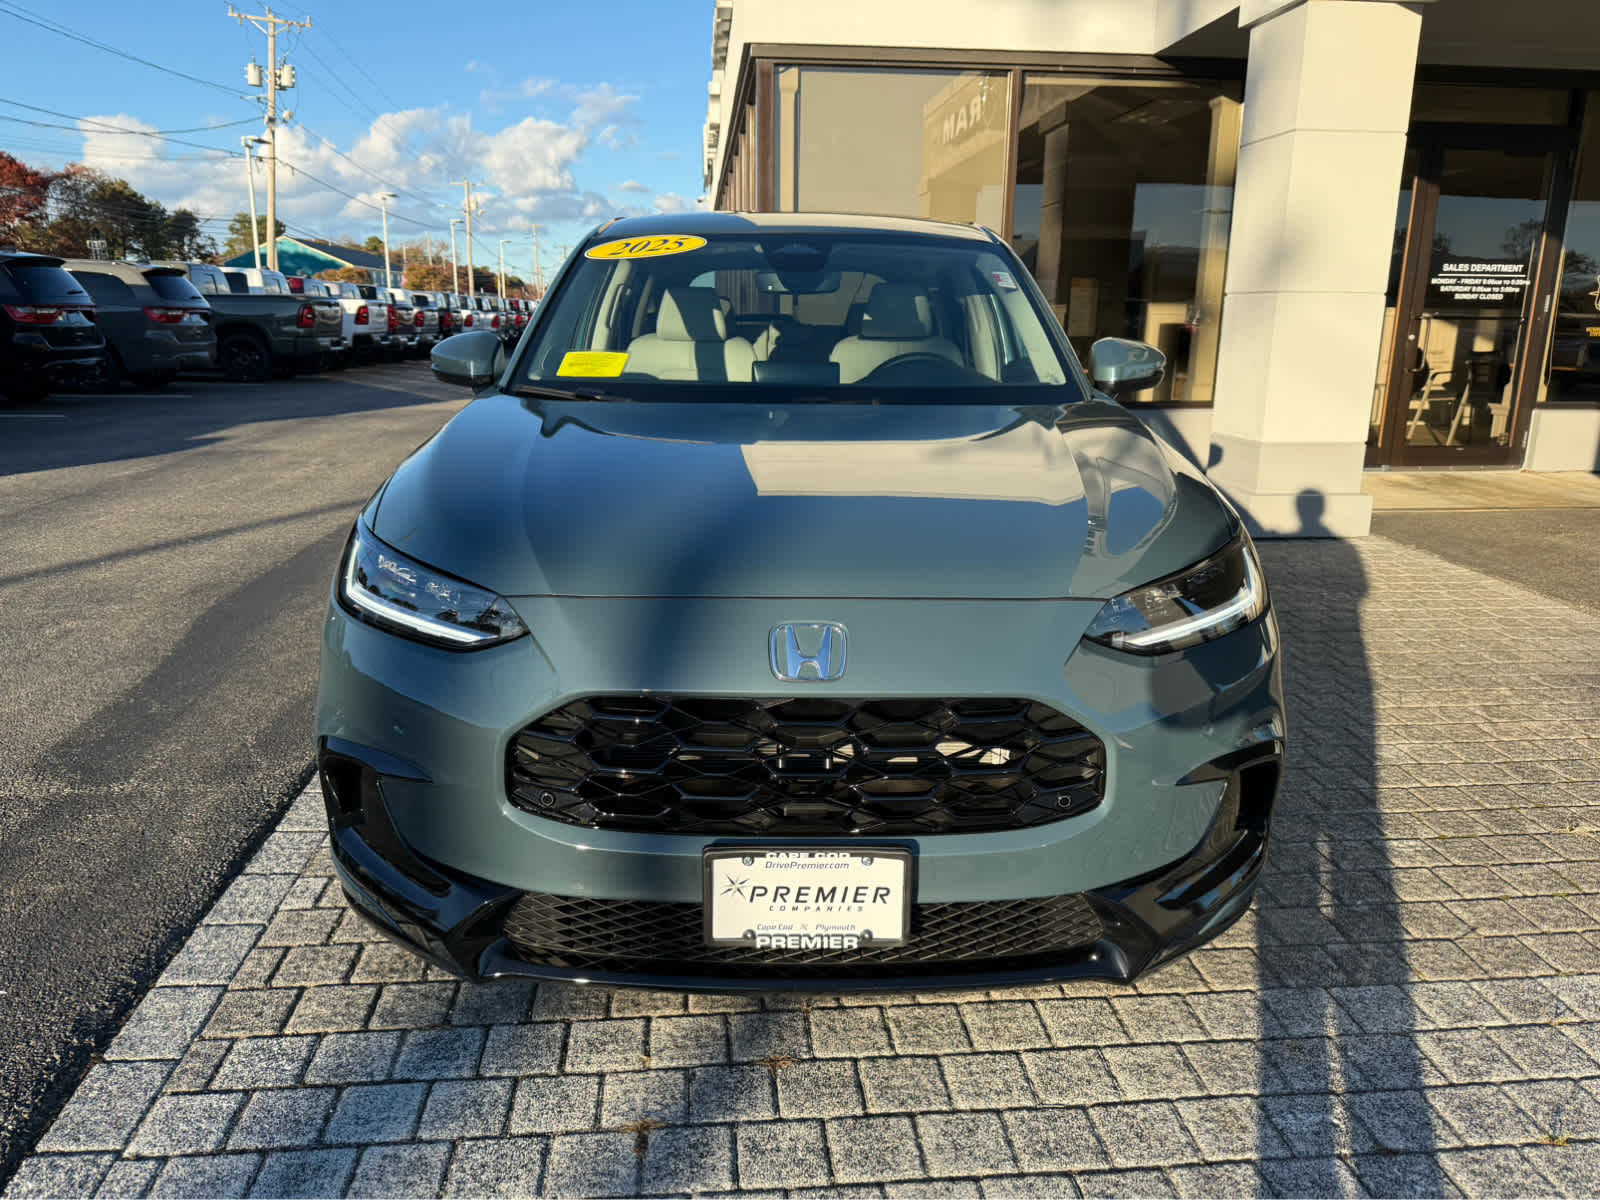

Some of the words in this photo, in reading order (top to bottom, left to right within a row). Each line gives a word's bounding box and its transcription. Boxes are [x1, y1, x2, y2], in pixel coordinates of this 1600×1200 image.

[608, 238, 690, 256] 2025
[1442, 263, 1469, 272] SALES
[1470, 264, 1524, 272] DEPARTMENT
[765, 861, 850, 870] DrivePremier.com
[750, 886, 891, 904] PREMIER
[756, 923, 776, 932] Cape
[778, 923, 794, 931] Cod
[815, 923, 856, 932] Plymouth
[756, 935, 859, 949] PREMIER
